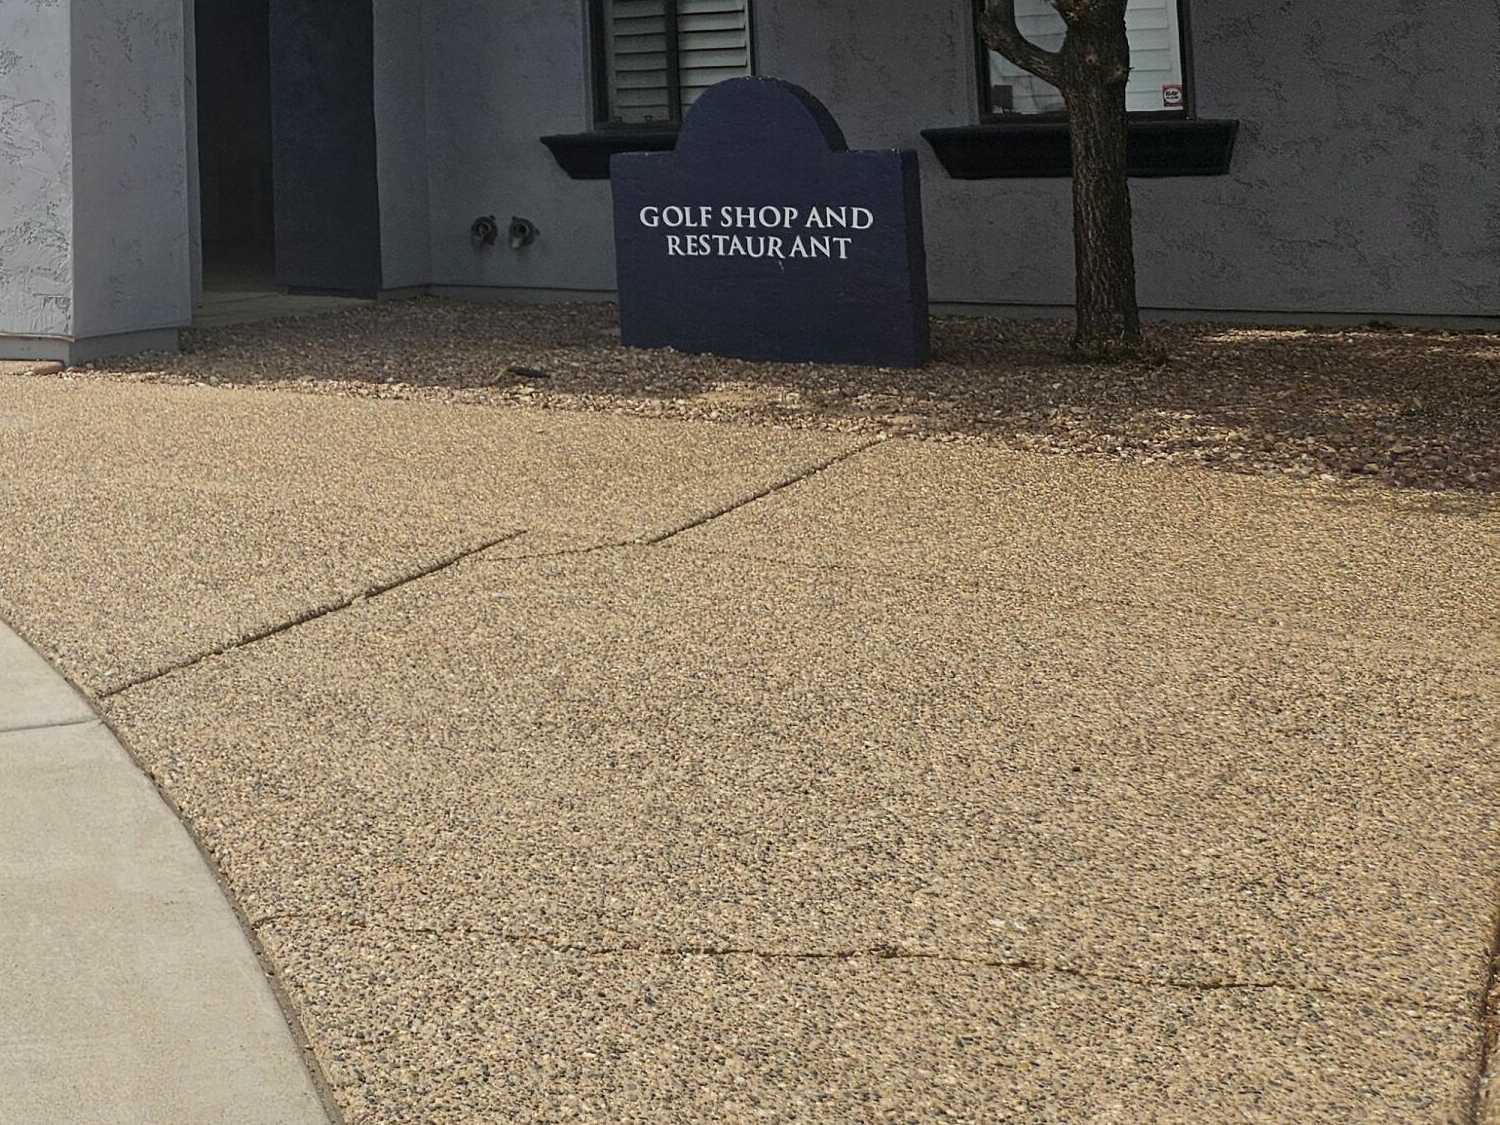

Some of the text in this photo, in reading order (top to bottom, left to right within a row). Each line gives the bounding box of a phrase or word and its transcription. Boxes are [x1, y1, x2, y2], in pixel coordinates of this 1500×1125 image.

[639, 206, 874, 230] GOLF SHOP AND
[666, 234, 852, 259] RESTAURANT
